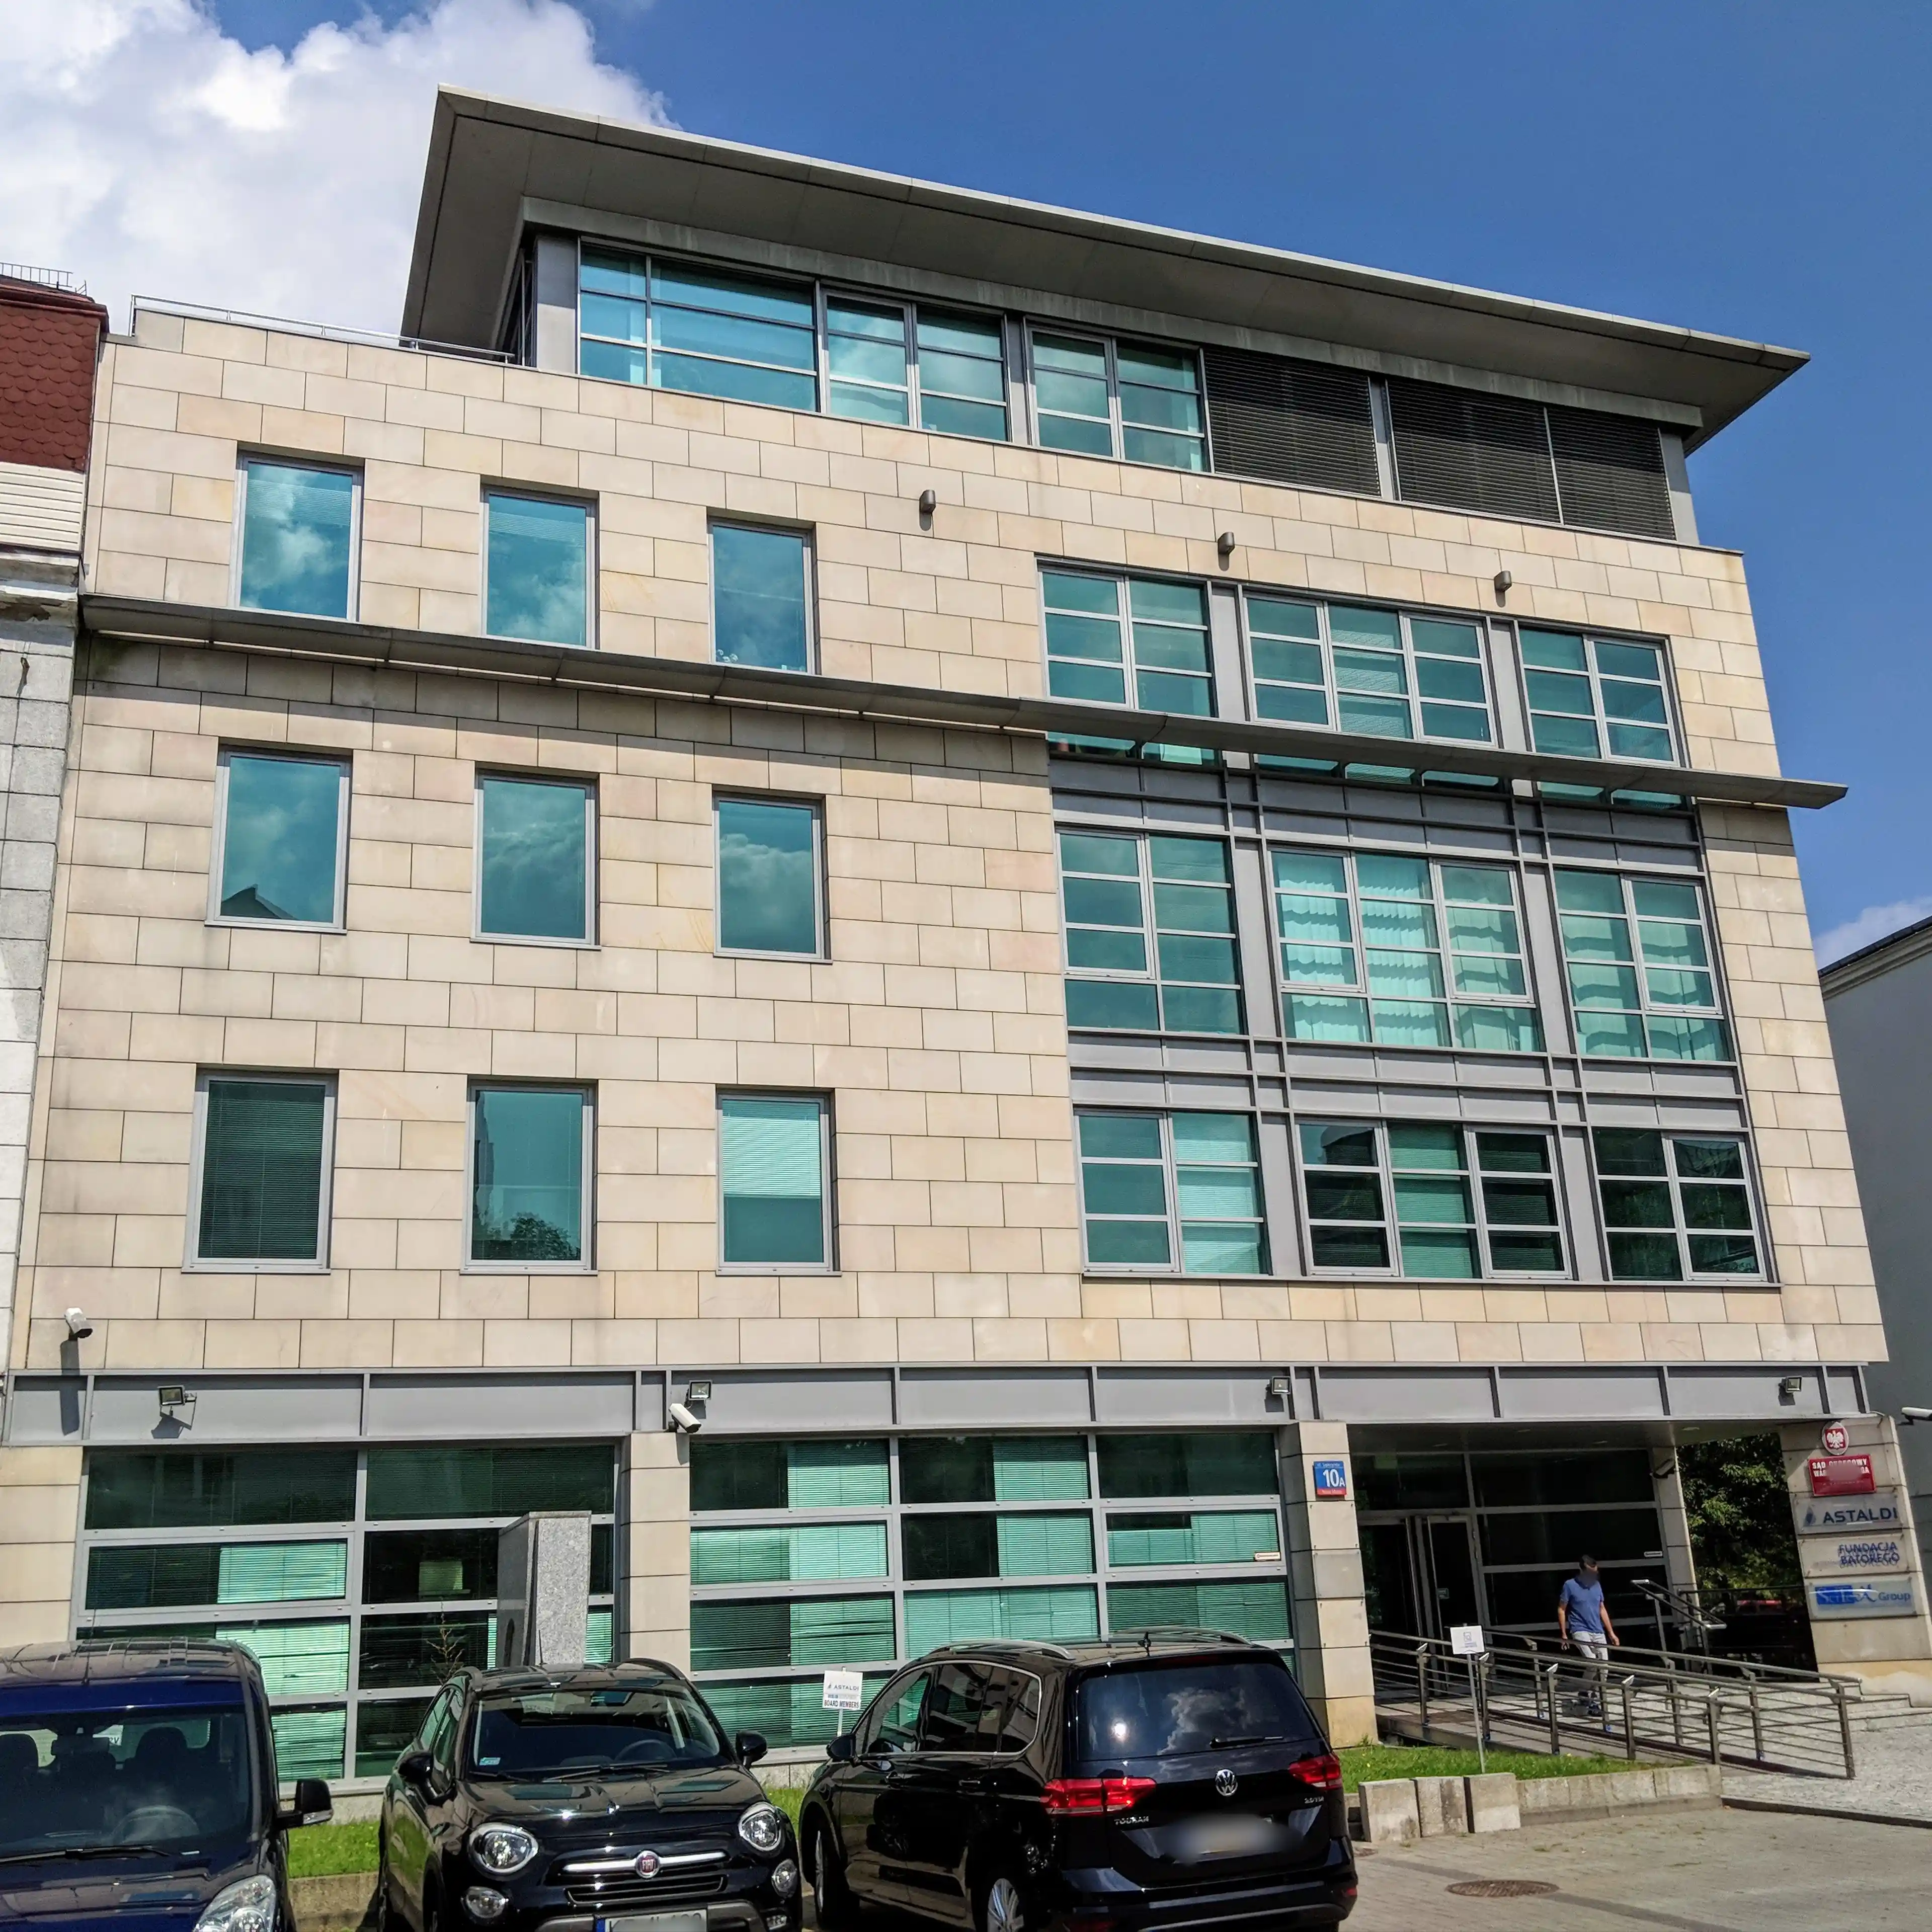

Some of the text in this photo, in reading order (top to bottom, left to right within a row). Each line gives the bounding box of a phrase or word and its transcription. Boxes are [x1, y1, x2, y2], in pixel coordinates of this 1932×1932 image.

[1823, 1507, 1898, 1523] ASTALDI
[1839, 1542, 1897, 1553] FUNDACJA
[1840, 1553, 1900, 1565] BATOREGO
[1878, 1592, 1911, 1602] Group
[1114, 1816, 1150, 1825] TOURAN
[642, 1859, 654, 1870] FIAT
